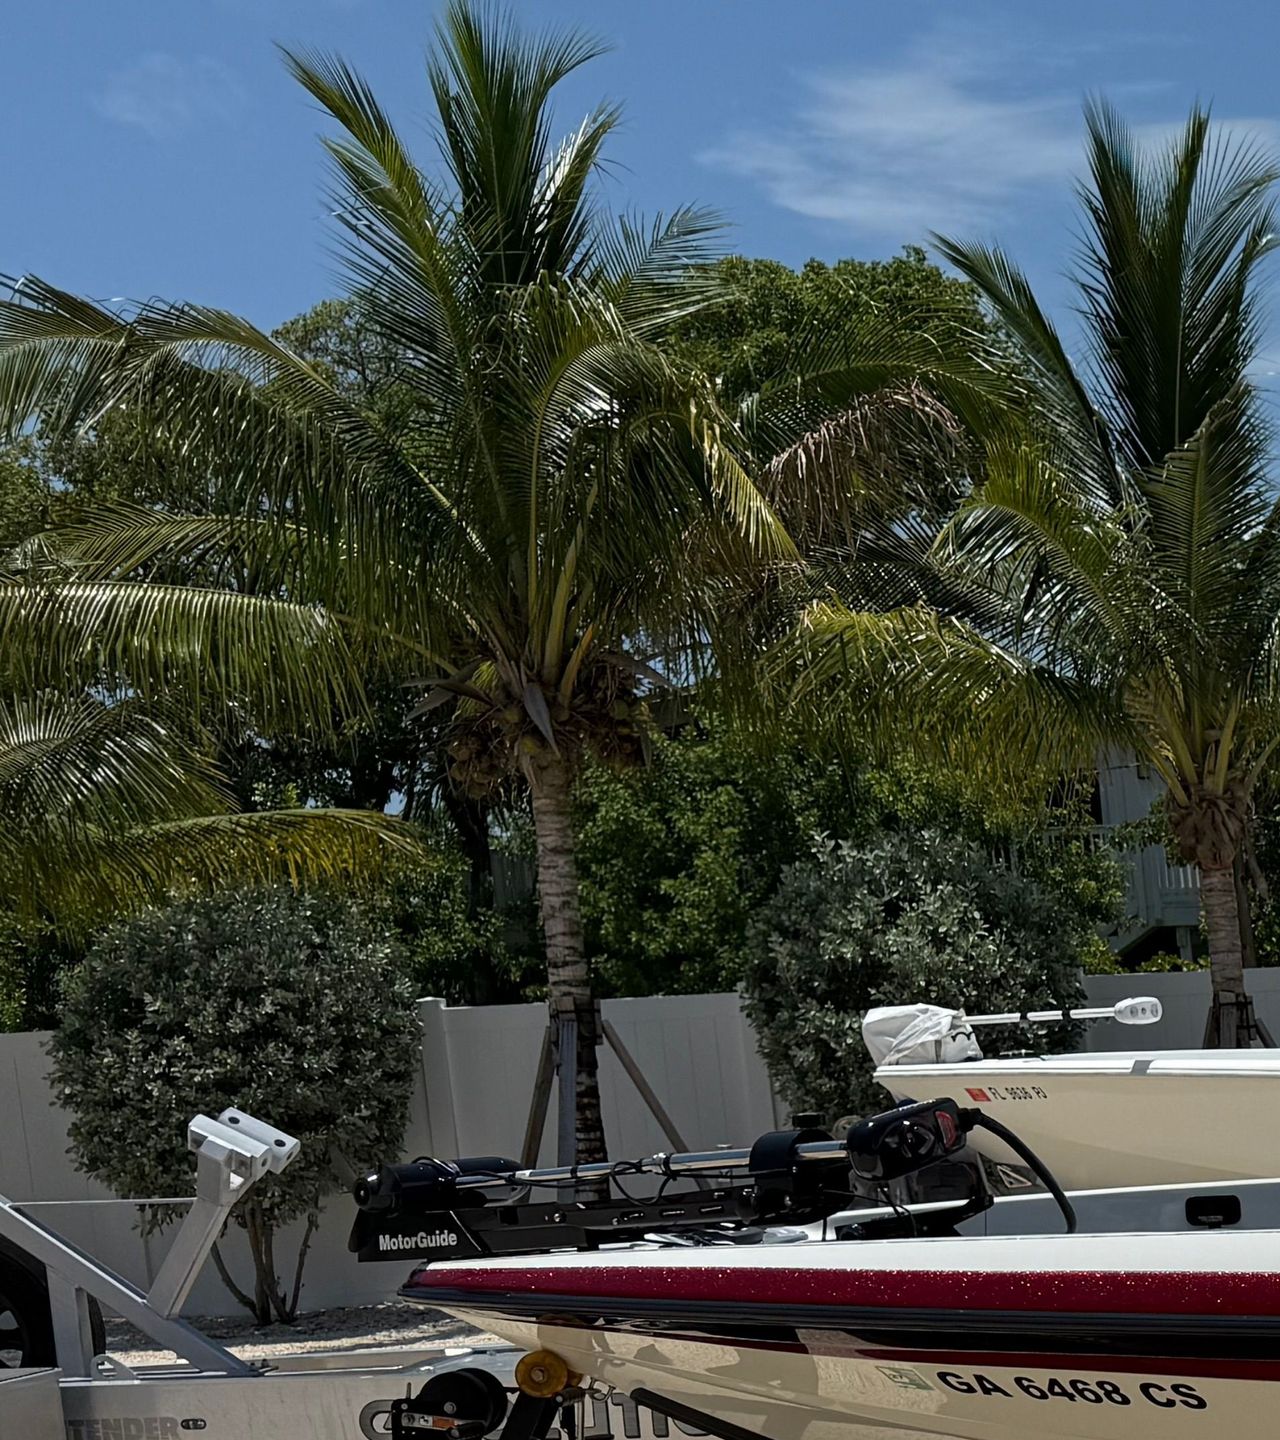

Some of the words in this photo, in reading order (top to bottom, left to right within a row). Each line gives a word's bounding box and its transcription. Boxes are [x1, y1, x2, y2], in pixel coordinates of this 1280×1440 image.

[987, 1086, 1007, 1100] FL
[378, 1229, 458, 1251] MotorGuide
[936, 1371, 1014, 1398] GA
[1013, 1376, 1131, 1405] 6468
[1139, 1382, 1208, 1410] CS
